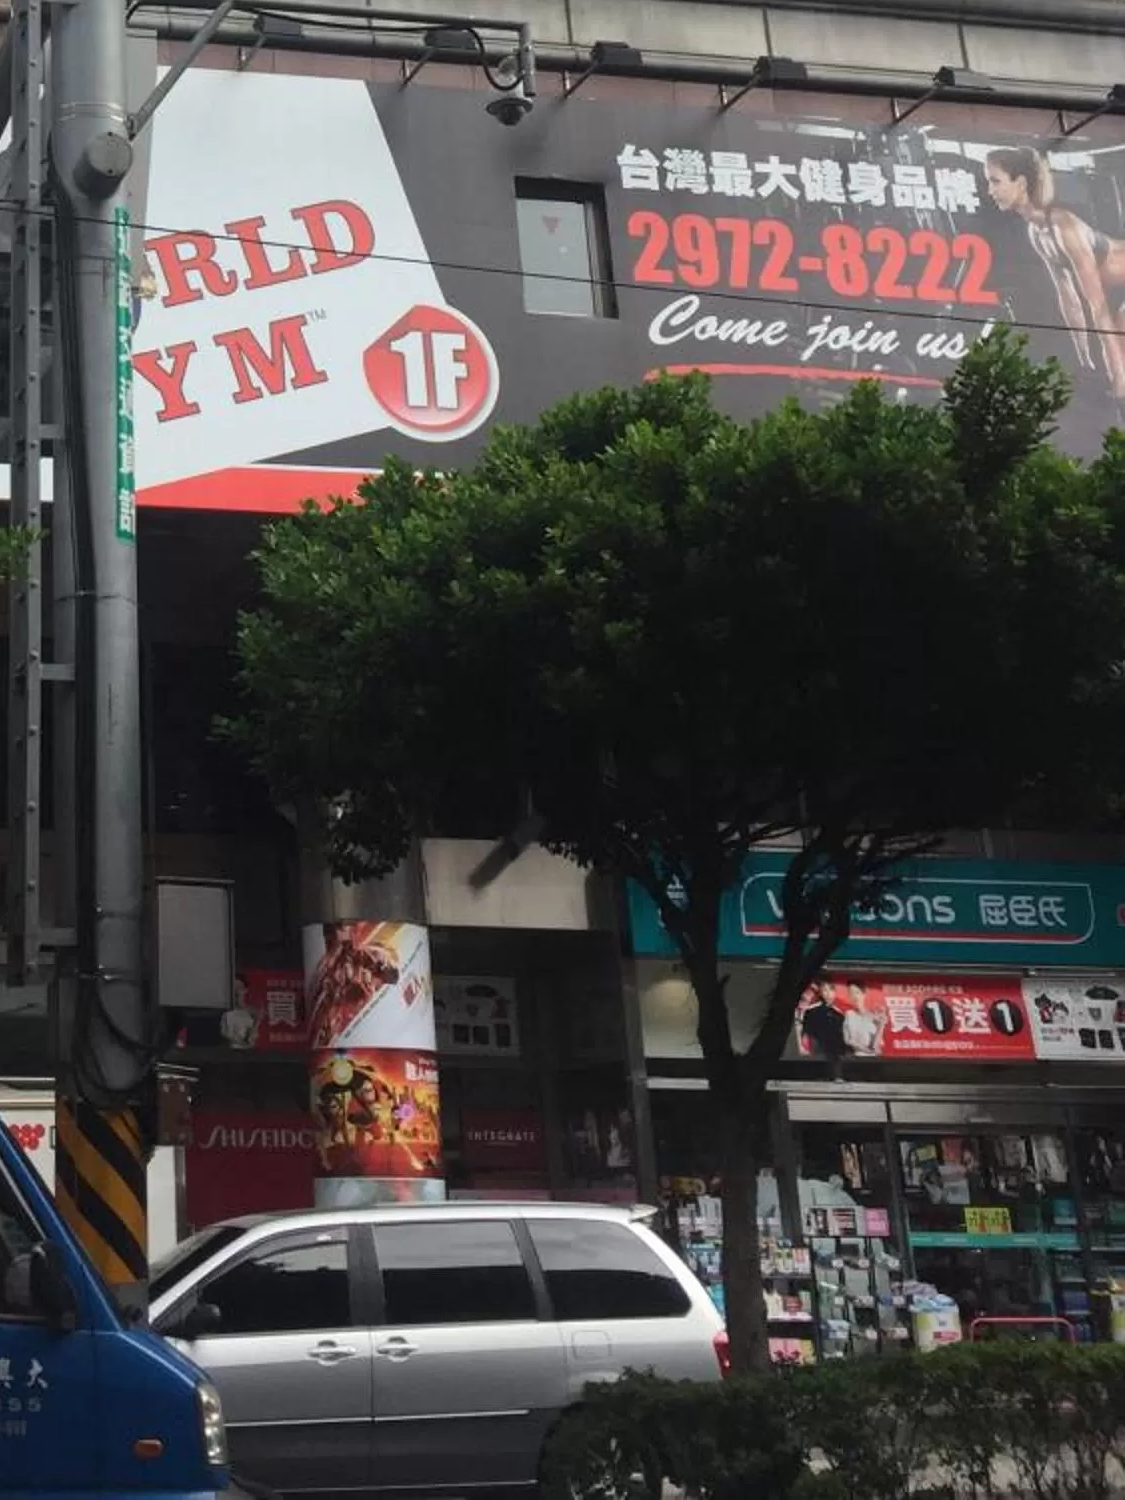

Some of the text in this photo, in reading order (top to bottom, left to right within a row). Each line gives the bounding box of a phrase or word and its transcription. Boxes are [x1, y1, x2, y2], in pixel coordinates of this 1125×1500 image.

[616, 144, 981, 214] 台灣最大健身品牌
[628, 211, 999, 305] 2972-8222
[648, 294, 789, 348] Come
[801, 315, 901, 361] join
[390, 331, 469, 411] 1F
[979, 894, 1068, 927] 屈臣氏
